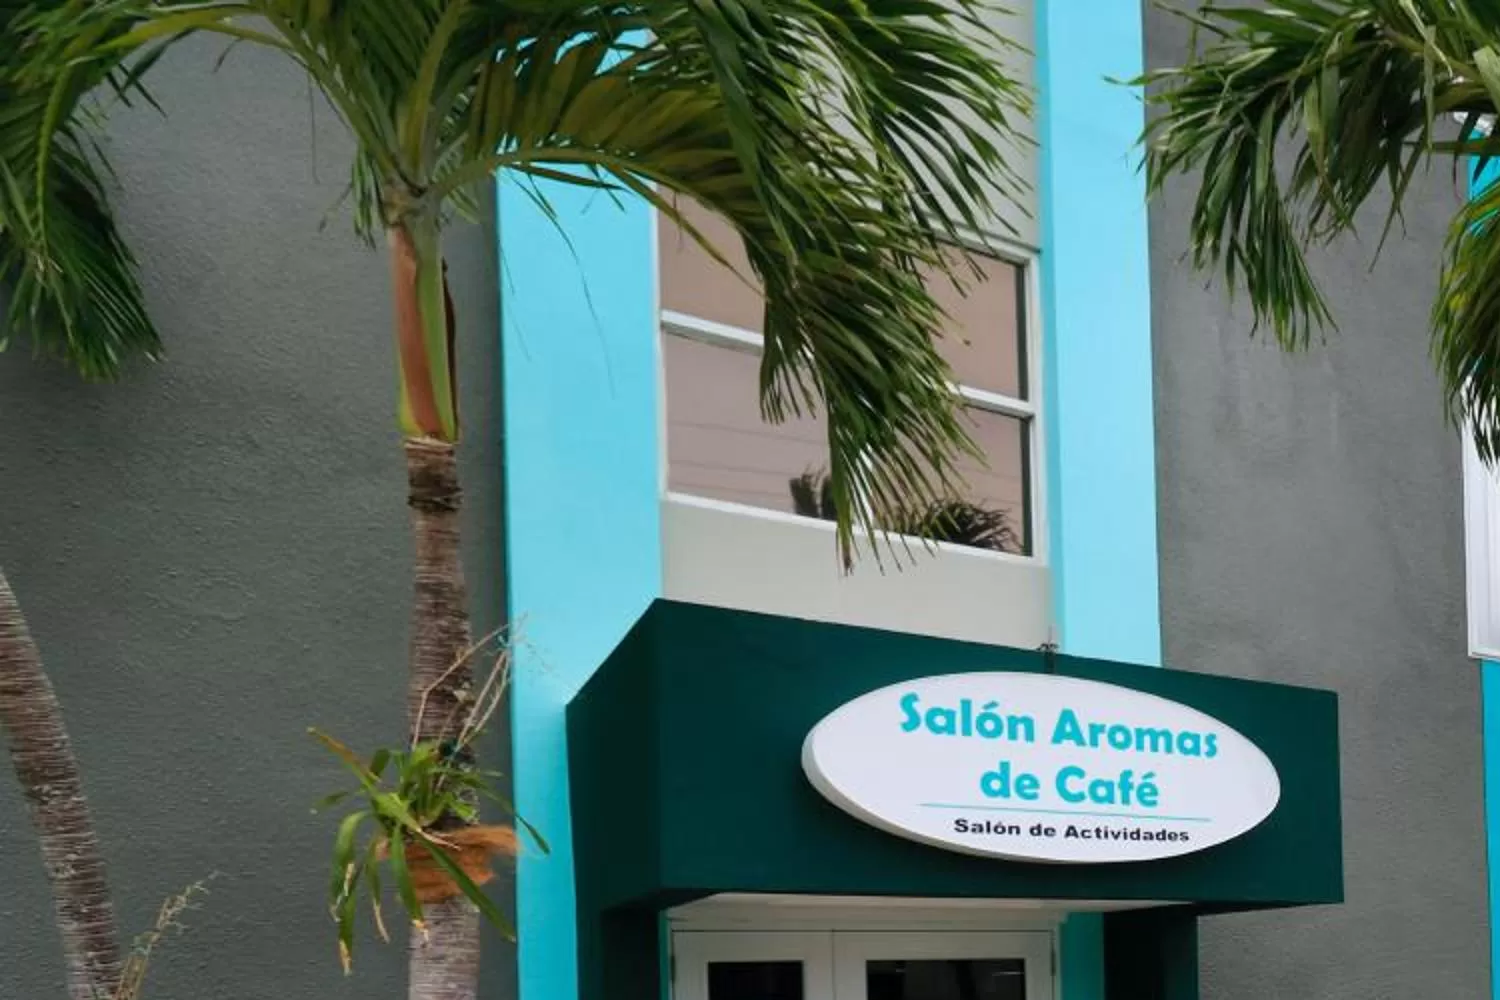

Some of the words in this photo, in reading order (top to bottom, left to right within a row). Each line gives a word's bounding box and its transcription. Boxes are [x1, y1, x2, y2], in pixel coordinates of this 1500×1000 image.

[899, 691, 1036, 744] Salón
[1051, 707, 1218, 759] Aromas
[979, 760, 1040, 801] de
[1055, 765, 1160, 809] Café
[954, 818, 1021, 836] Salón
[1029, 823, 1056, 837] de
[1065, 825, 1189, 841] Actividades
